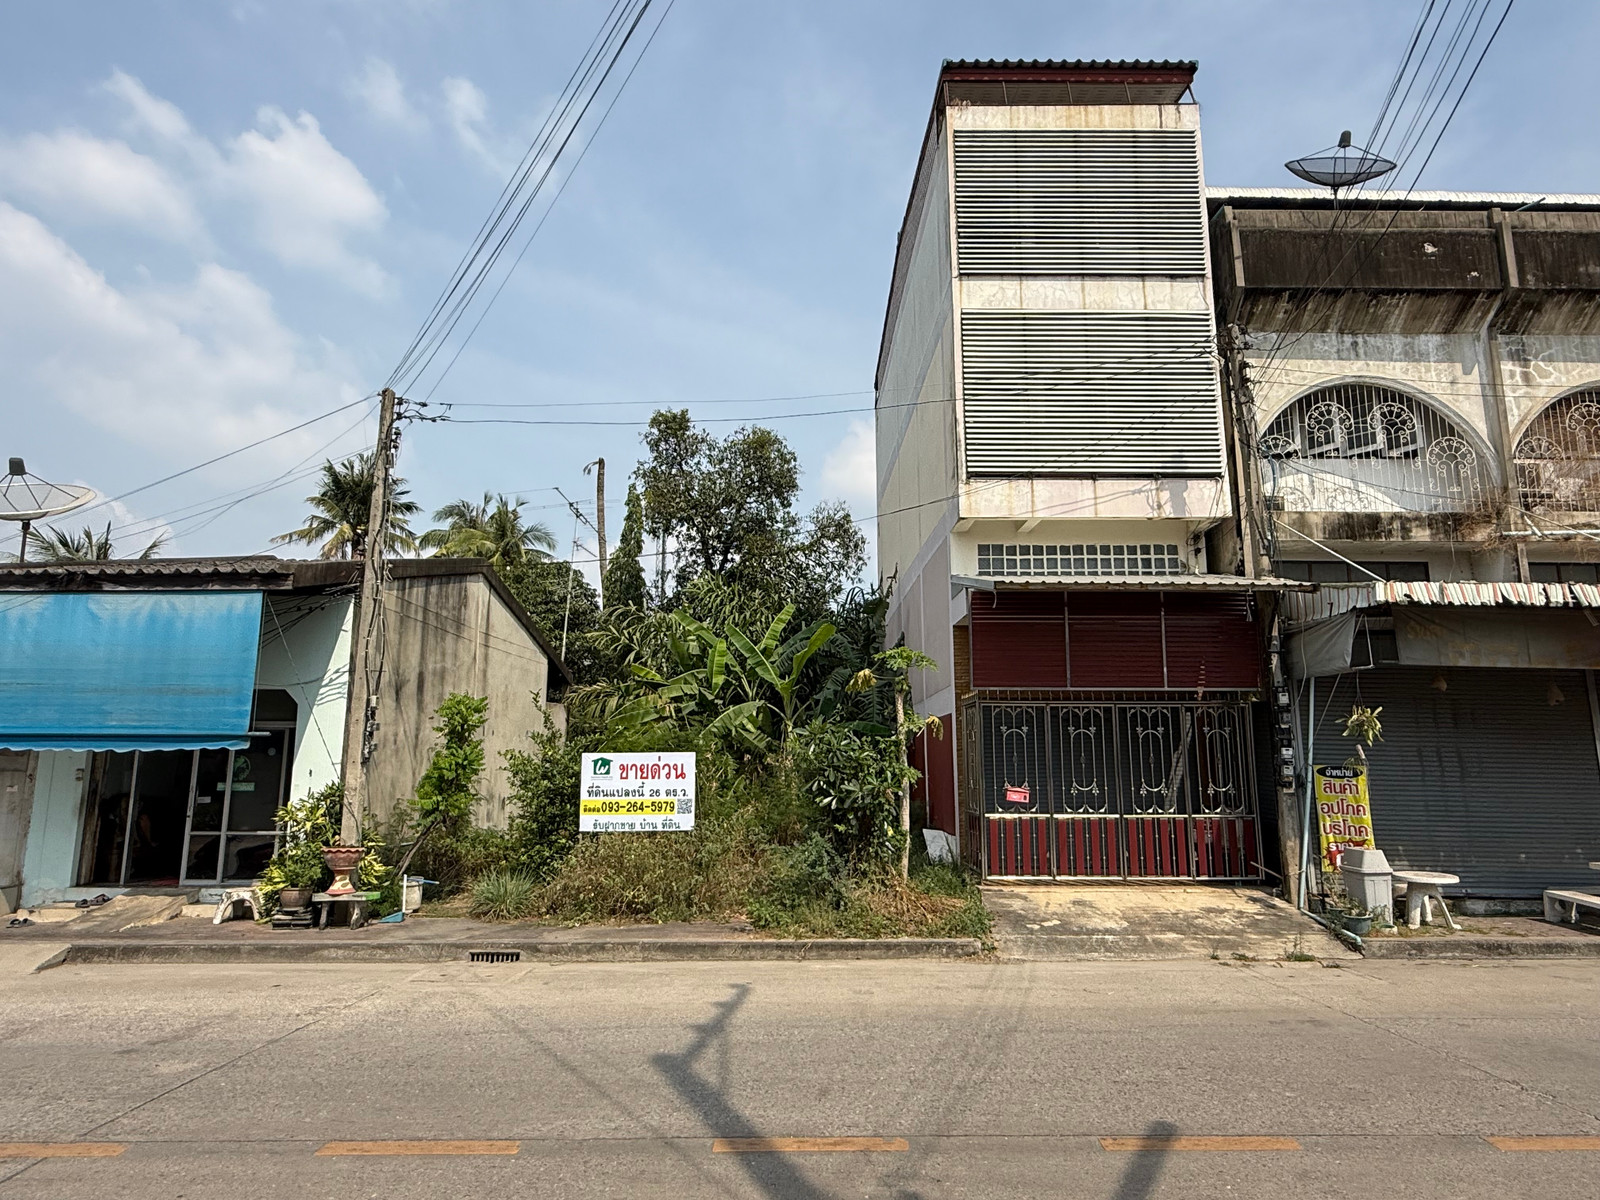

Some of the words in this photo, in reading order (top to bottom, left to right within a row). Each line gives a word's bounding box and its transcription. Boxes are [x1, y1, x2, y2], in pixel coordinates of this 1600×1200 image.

[619, 755, 687, 780] ขายด่วน
[1325, 767, 1354, 777] จำหน่าย
[586, 781, 645, 798] ที่ดินแปลงนี้
[649, 788, 661, 797] 26
[665, 788, 689, 798] ตร.ว.
[1323, 779, 1359, 795] สินค้า
[583, 804, 601, 813] ติดต่อ
[601, 801, 675, 813] 093-264-5979
[1320, 798, 1367, 818] อุปโภค
[593, 819, 636, 831] รับฝากขาย
[640, 818, 658, 830] บ้าน
[661, 816, 681, 830] ที่ดิน
[1322, 819, 1369, 838] บริโภค
